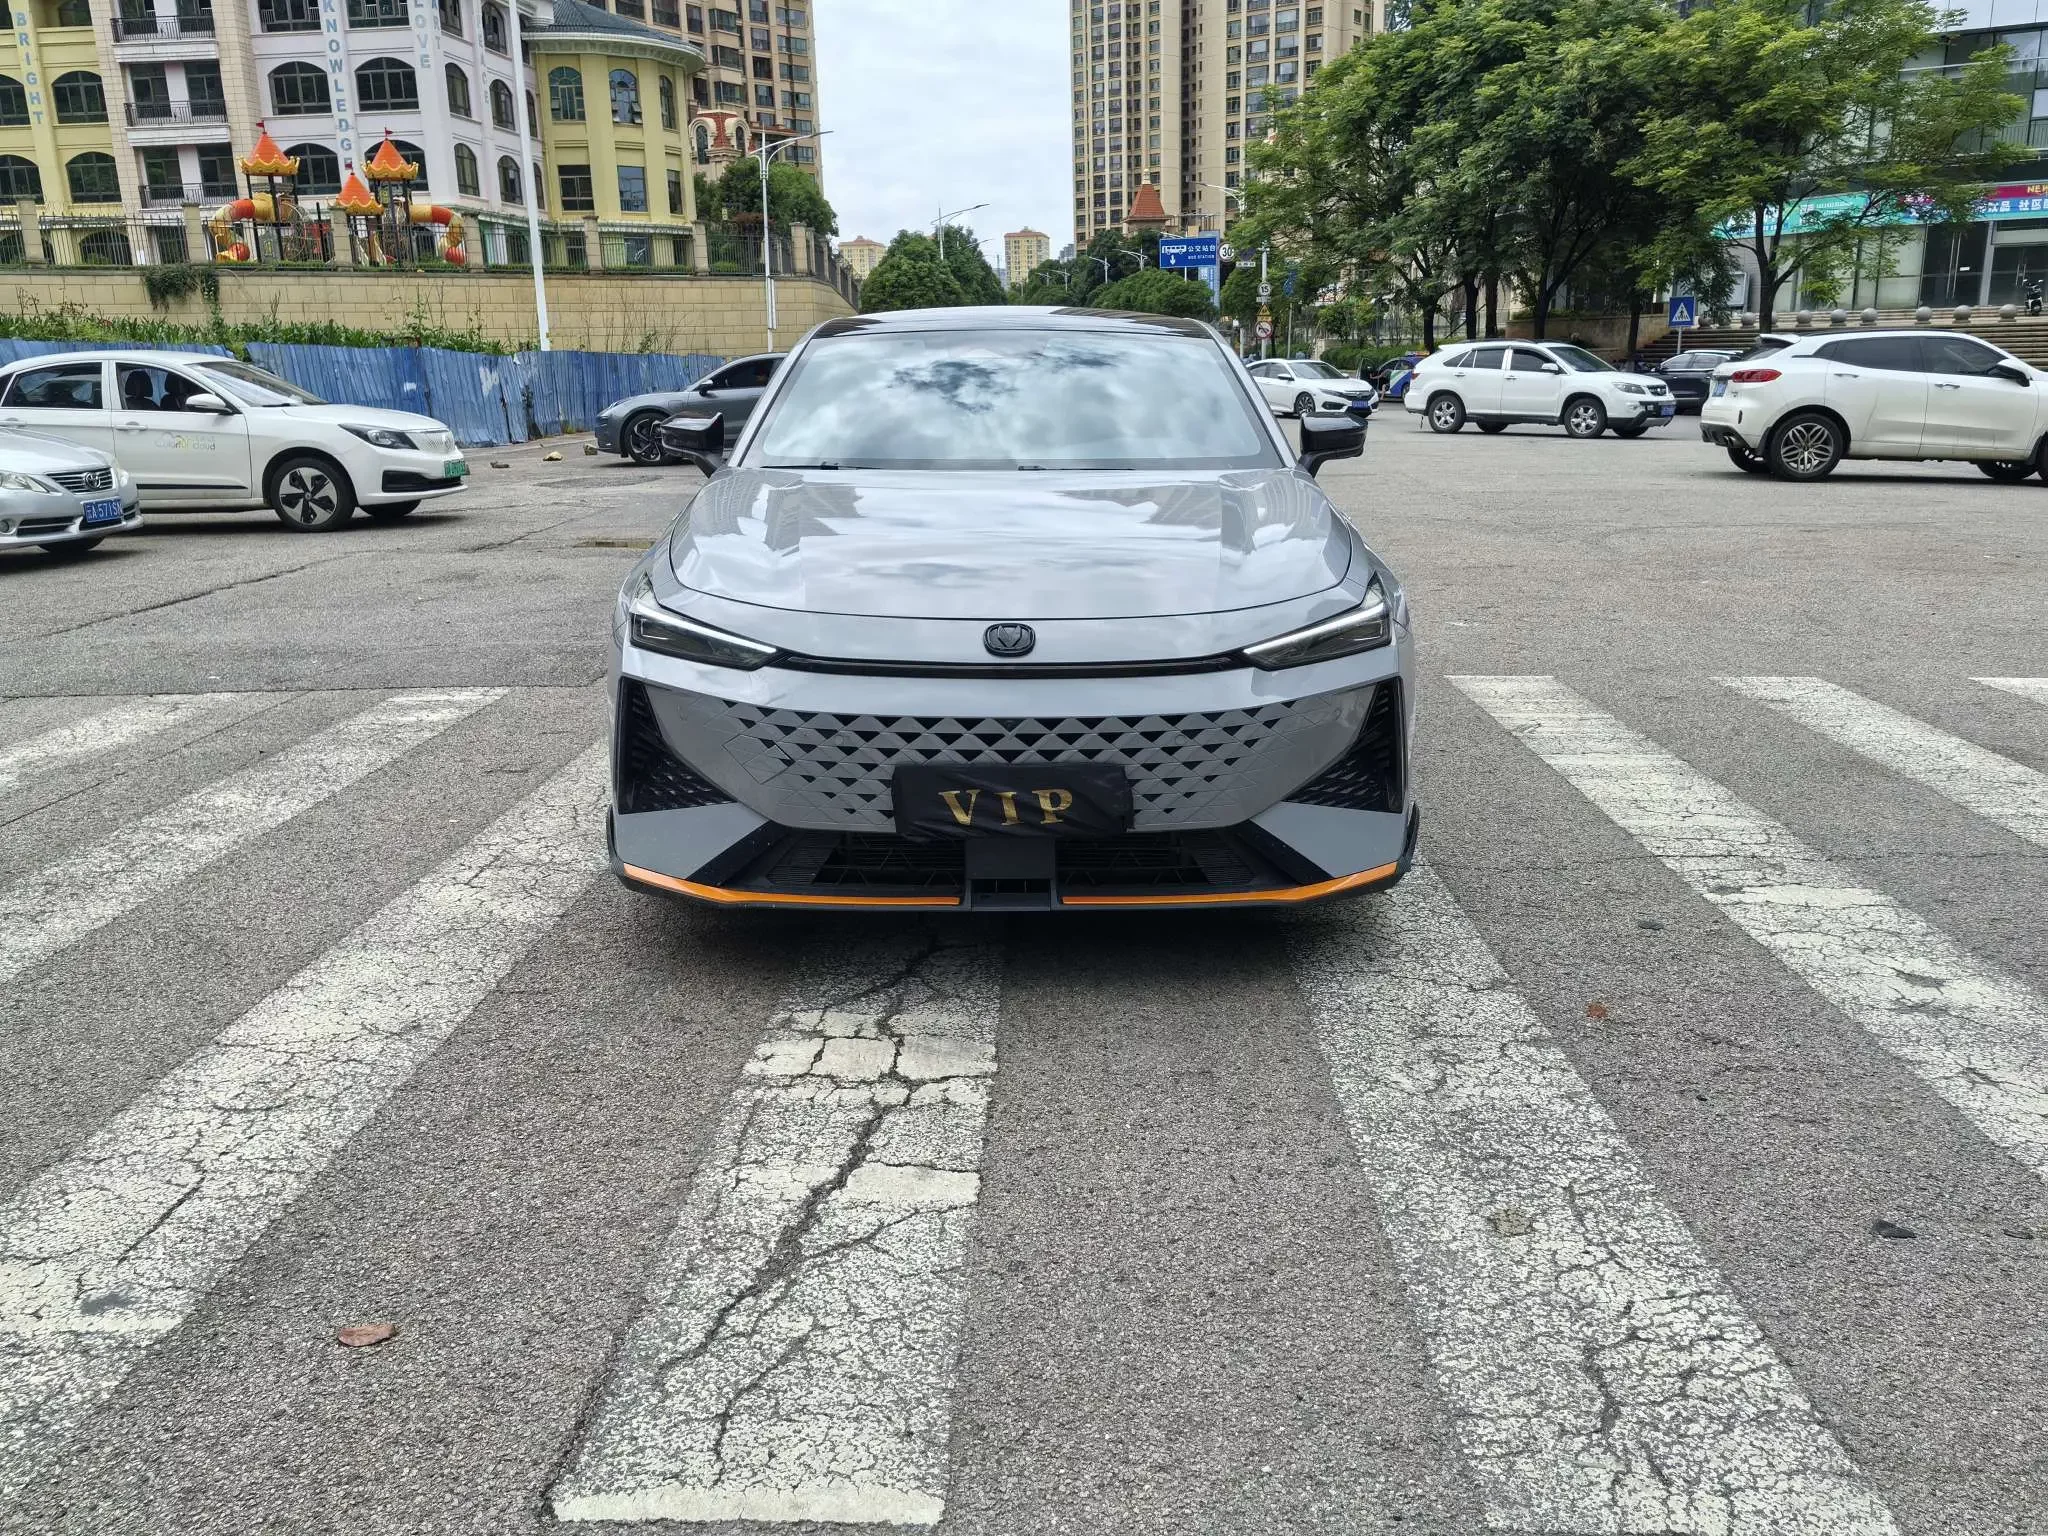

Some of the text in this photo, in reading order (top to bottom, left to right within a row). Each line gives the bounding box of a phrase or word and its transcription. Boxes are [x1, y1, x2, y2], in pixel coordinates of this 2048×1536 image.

[16, 12, 43, 124] BRIGHT
[1187, 244, 1216, 252] 公交站台
[1222, 247, 1232, 257] 30
[938, 789, 1073, 826] VIP
